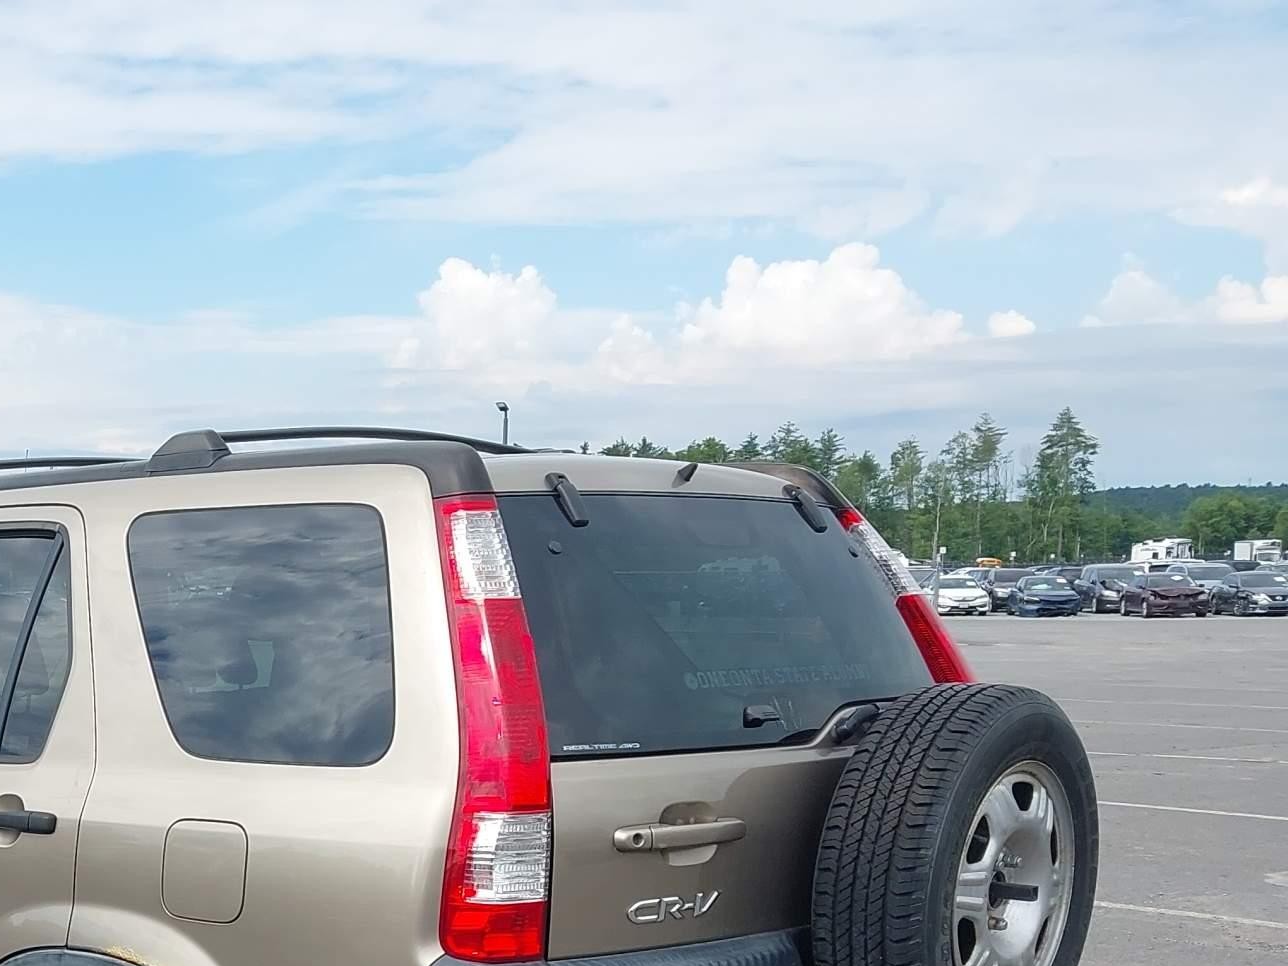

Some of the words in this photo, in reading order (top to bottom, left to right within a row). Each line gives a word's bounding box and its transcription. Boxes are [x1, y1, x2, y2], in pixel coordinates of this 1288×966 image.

[696, 668, 772, 688] ONEONTA
[774, 665, 820, 685] STATE
[627, 890, 721, 925] CR-V
